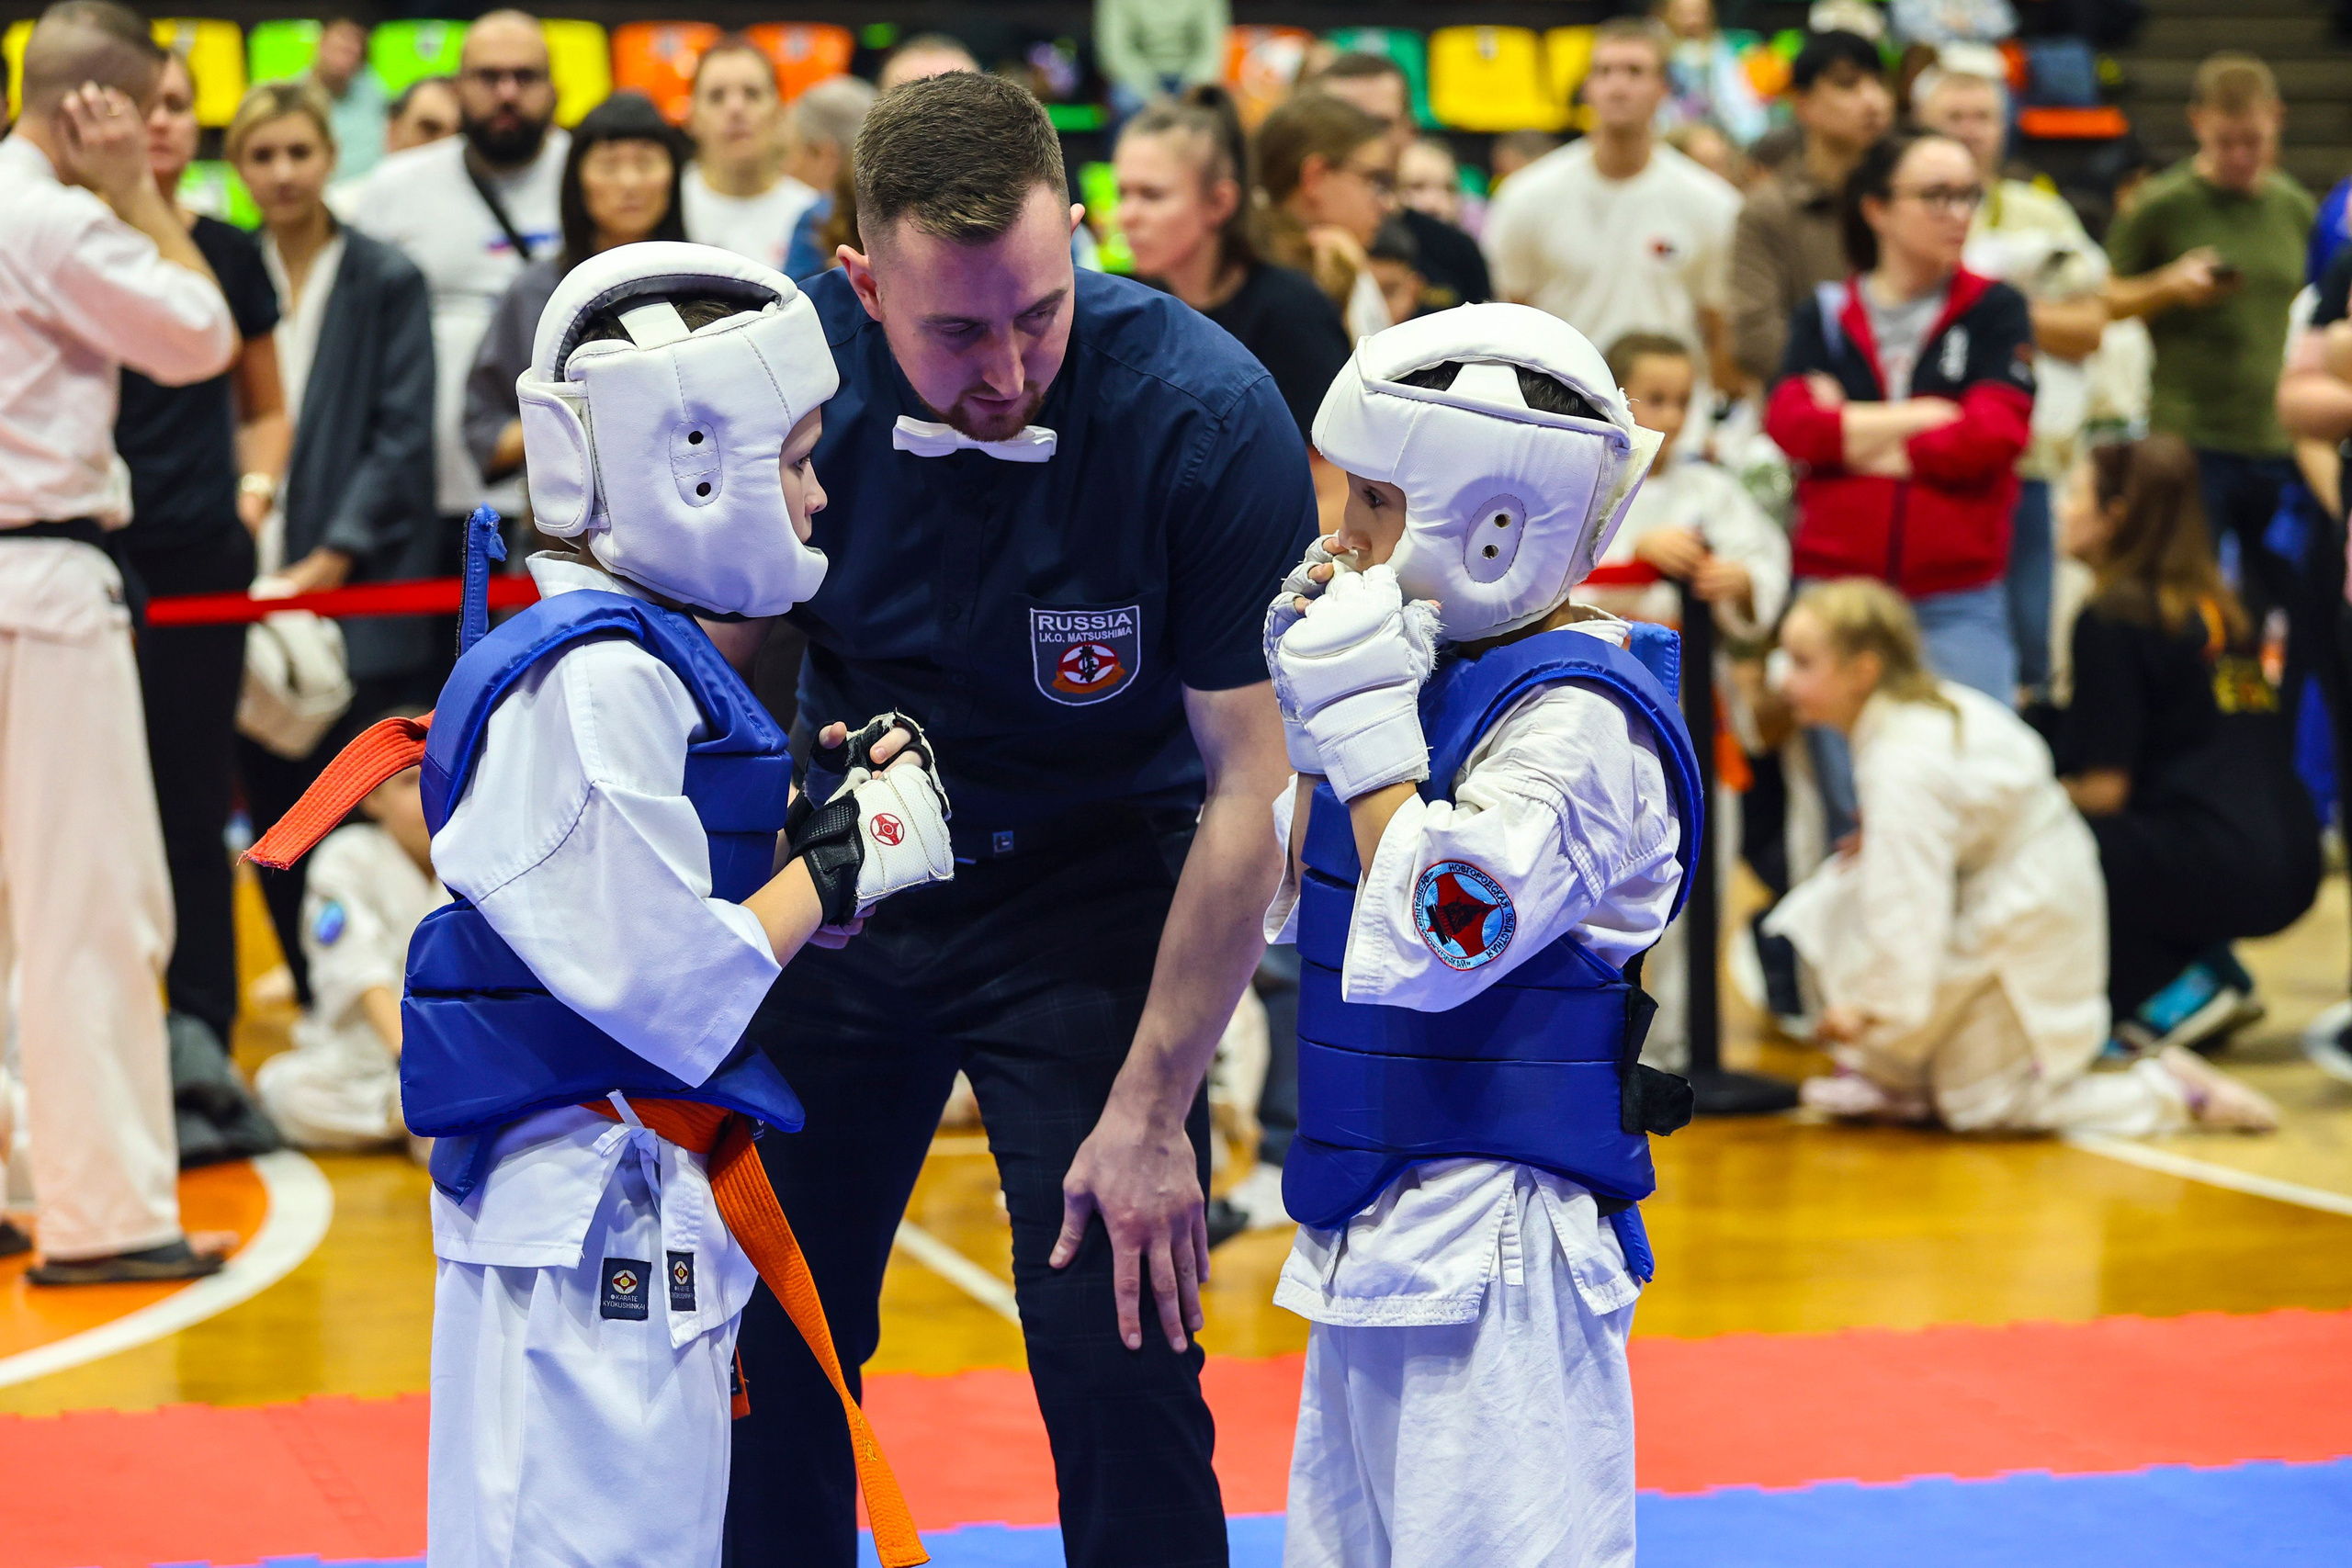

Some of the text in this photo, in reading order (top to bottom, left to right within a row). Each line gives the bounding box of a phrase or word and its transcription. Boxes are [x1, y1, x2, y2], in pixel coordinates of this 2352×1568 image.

[1038, 613, 1133, 631] RUSSIA
[1068, 626, 1133, 643] MATSUSHIMA
[1448, 863, 1514, 959] НОВГОРОДСКАЯ ОБЛАСТНАЯ
[603, 1300, 646, 1311] KYOKUSHINKAI
[615, 1294, 639, 1303] KARATE
